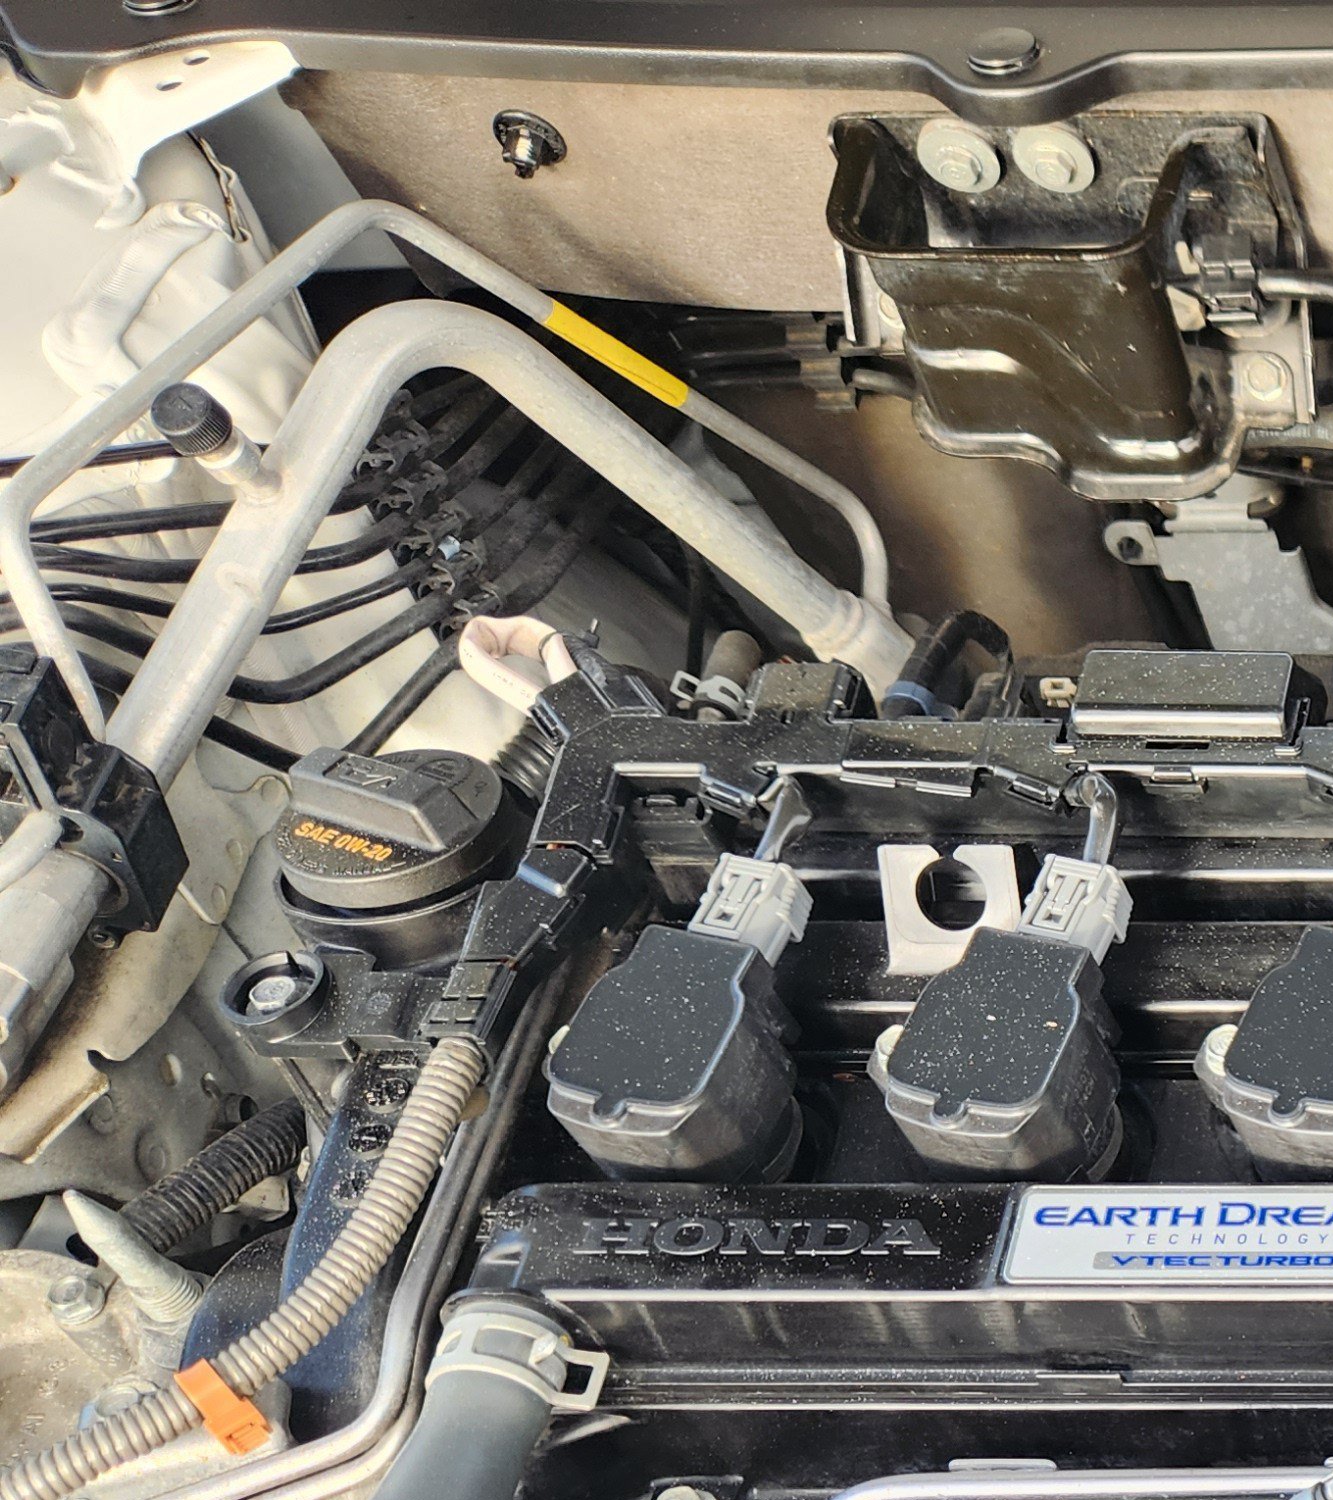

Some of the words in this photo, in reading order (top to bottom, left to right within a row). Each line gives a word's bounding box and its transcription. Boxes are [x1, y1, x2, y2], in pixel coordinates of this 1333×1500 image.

[294, 820, 339, 844] SAE
[333, 832, 393, 862] 0W-20
[1034, 1205, 1205, 1227] EARTH
[573, 1217, 941, 1255] HONDA
[1125, 1232, 1331, 1246] TECHNOLOGY
[1111, 1254, 1213, 1267] VTEC
